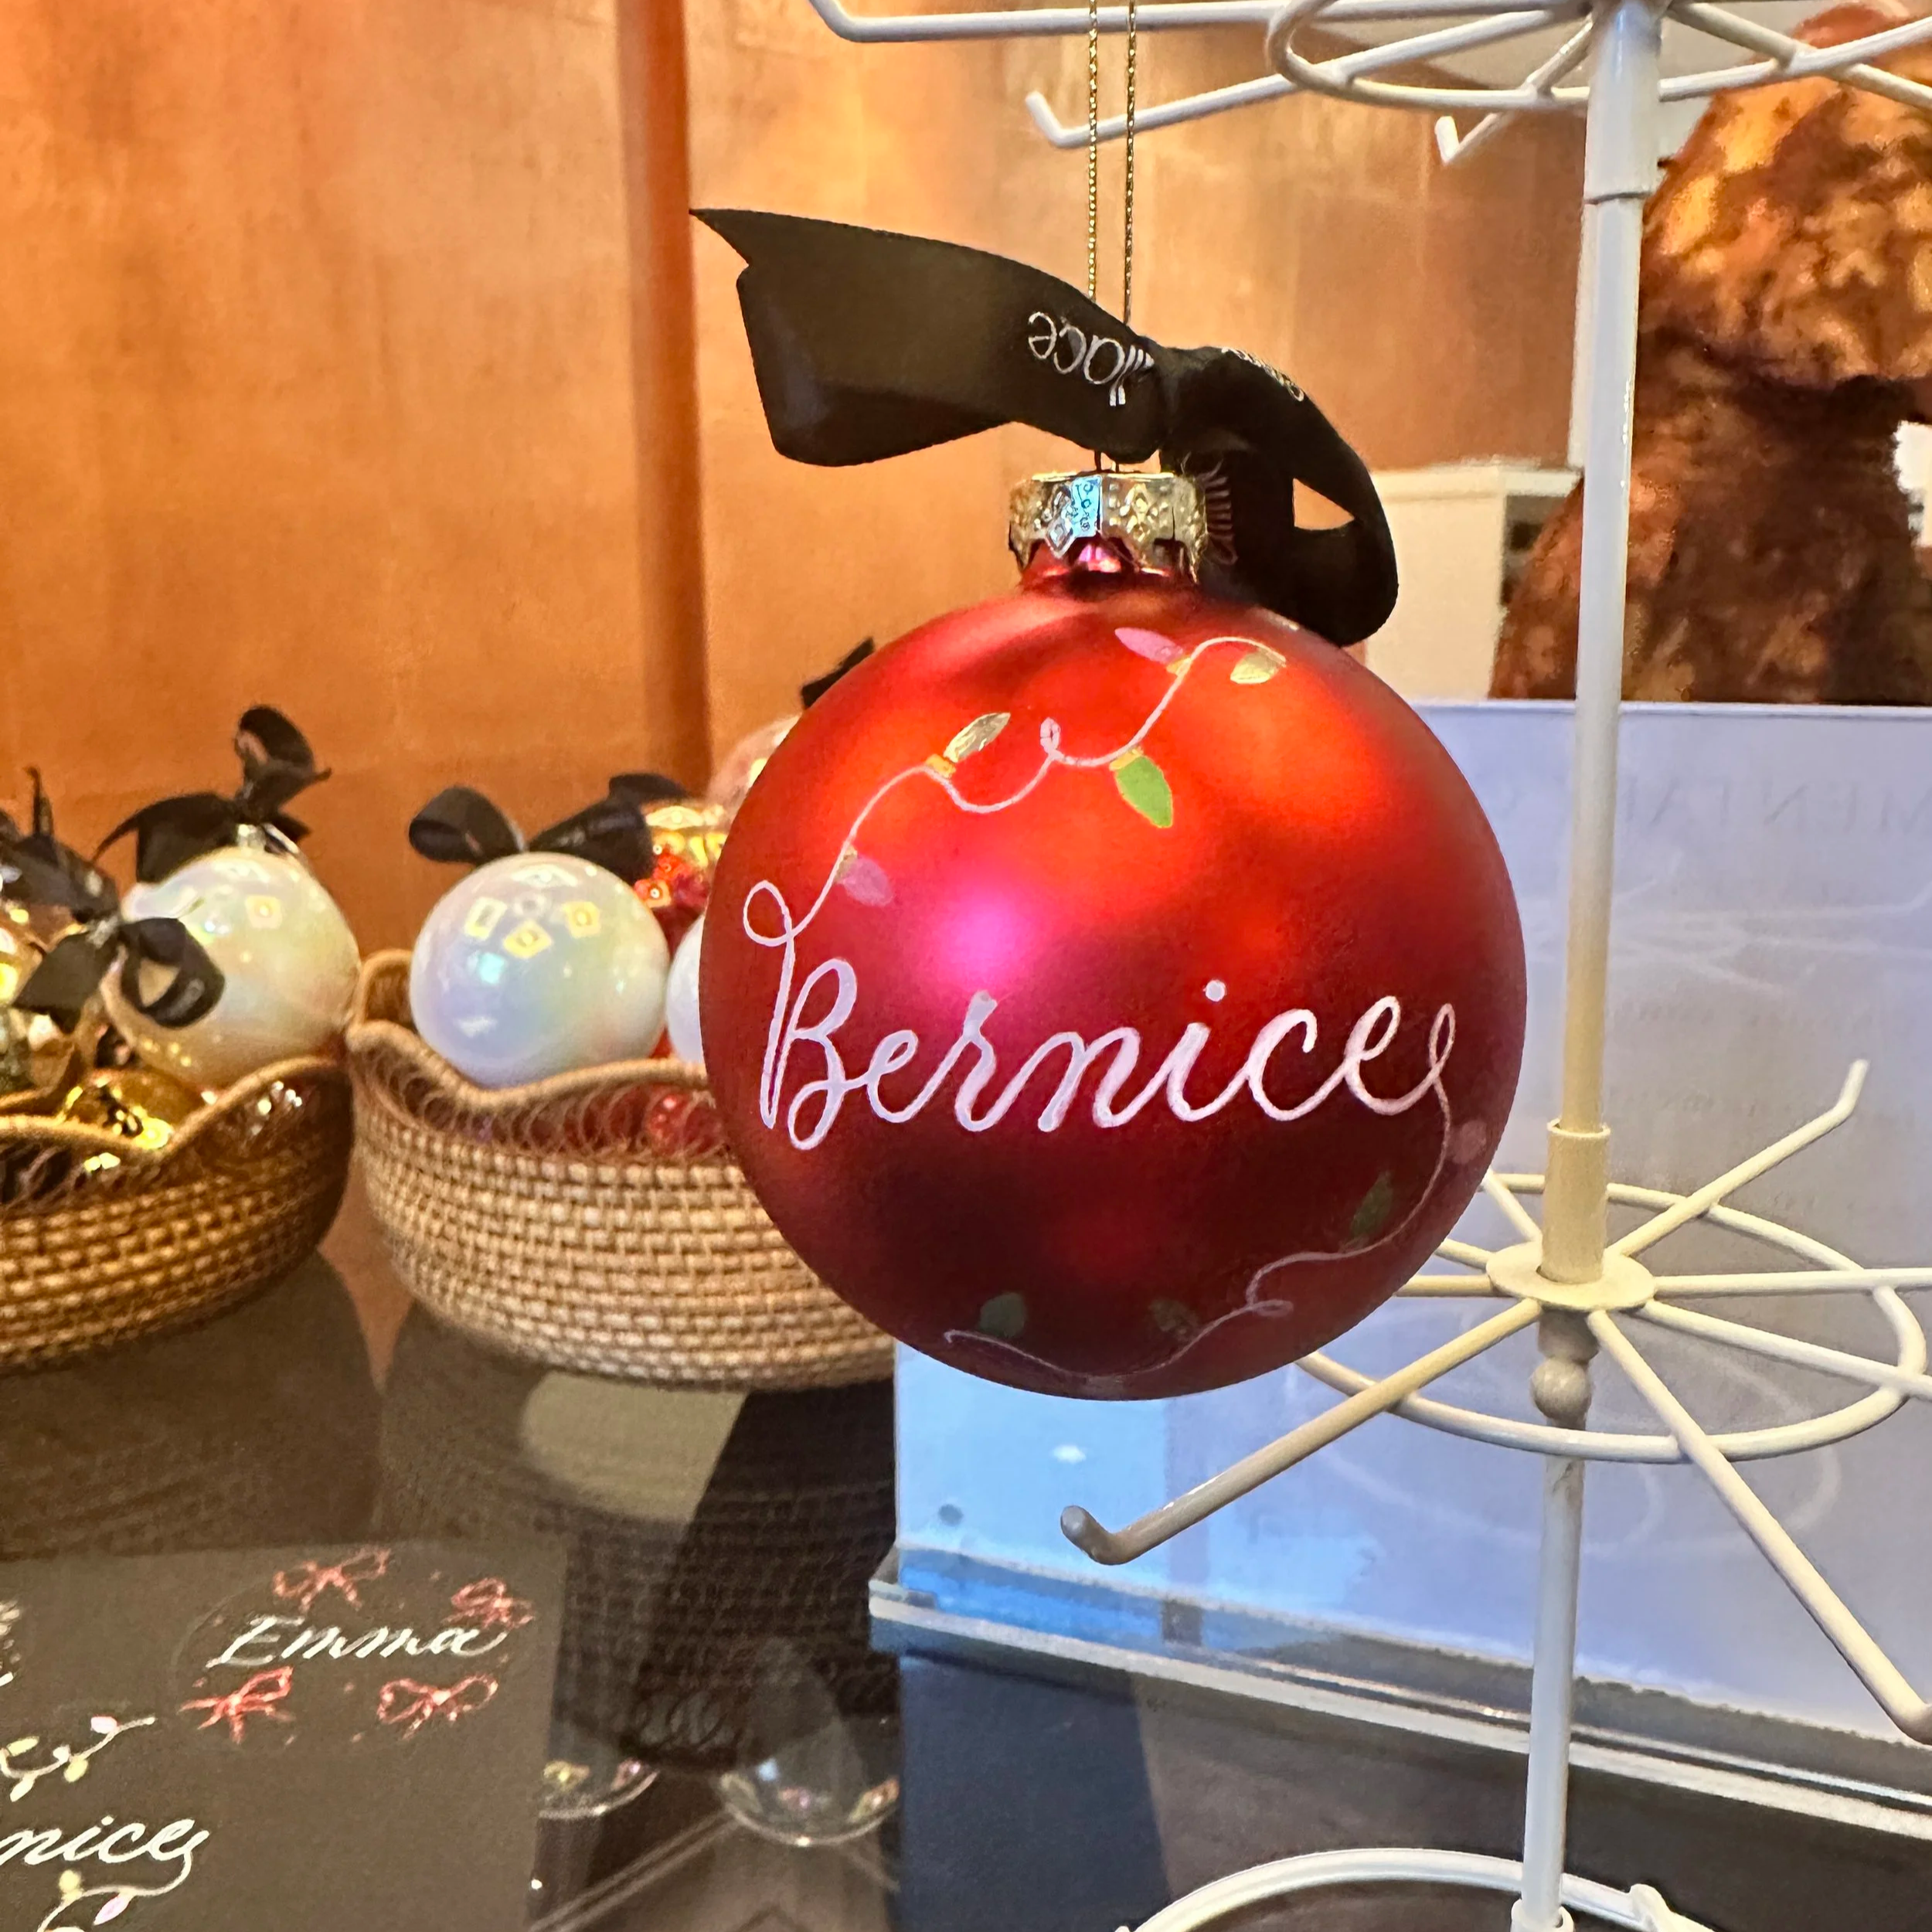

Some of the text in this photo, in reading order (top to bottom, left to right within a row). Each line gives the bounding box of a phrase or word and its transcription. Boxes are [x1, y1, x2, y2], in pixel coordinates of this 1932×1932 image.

[759, 947, 1456, 1151] Bernice
[205, 1615, 509, 1668] Emma
[0, 1815, 210, 1866] nice
